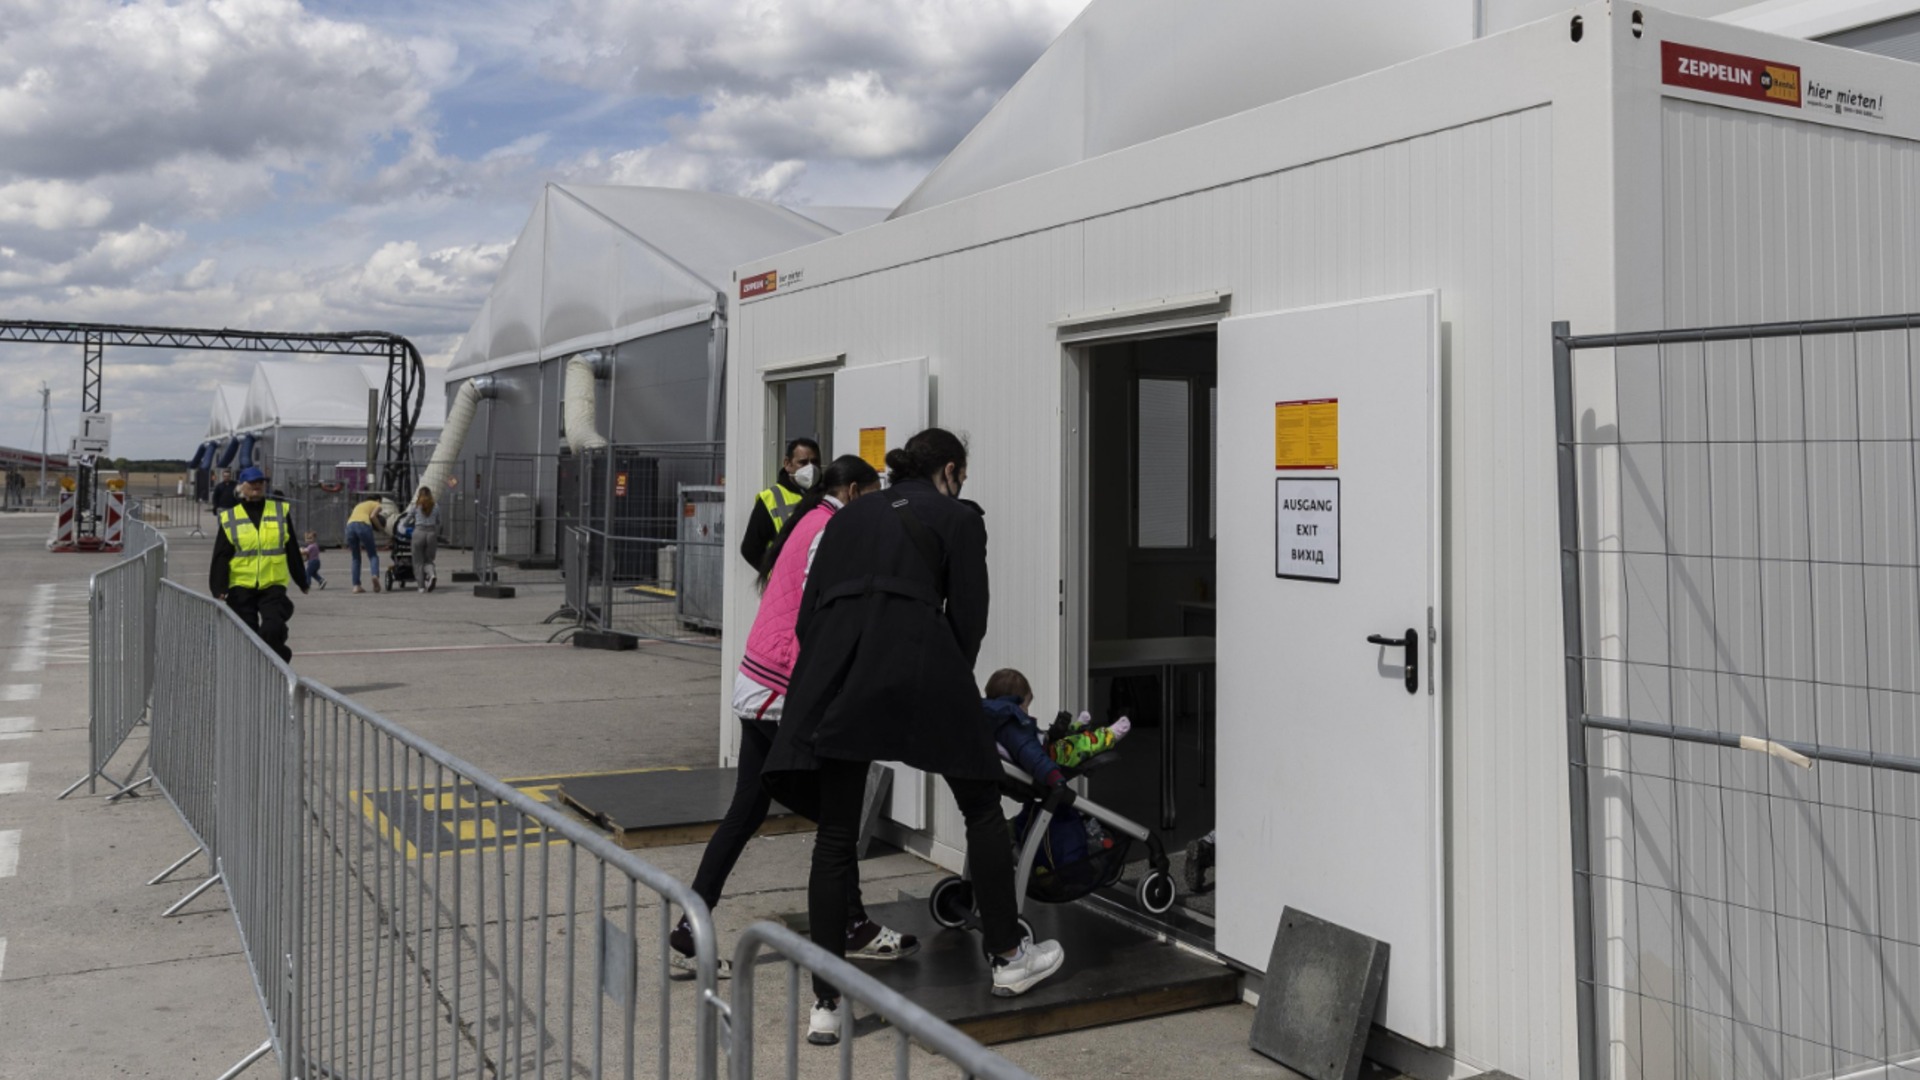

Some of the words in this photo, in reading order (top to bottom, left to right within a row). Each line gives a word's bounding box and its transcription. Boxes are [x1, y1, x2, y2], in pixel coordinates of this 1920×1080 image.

[1678, 57, 1752, 86] ZEPPELIN
[1807, 80, 1832, 100] hier
[1283, 498, 1333, 512] AUSGANG
[1296, 523, 1319, 537] EXIT
[1291, 548, 1325, 565] ВИХІД
